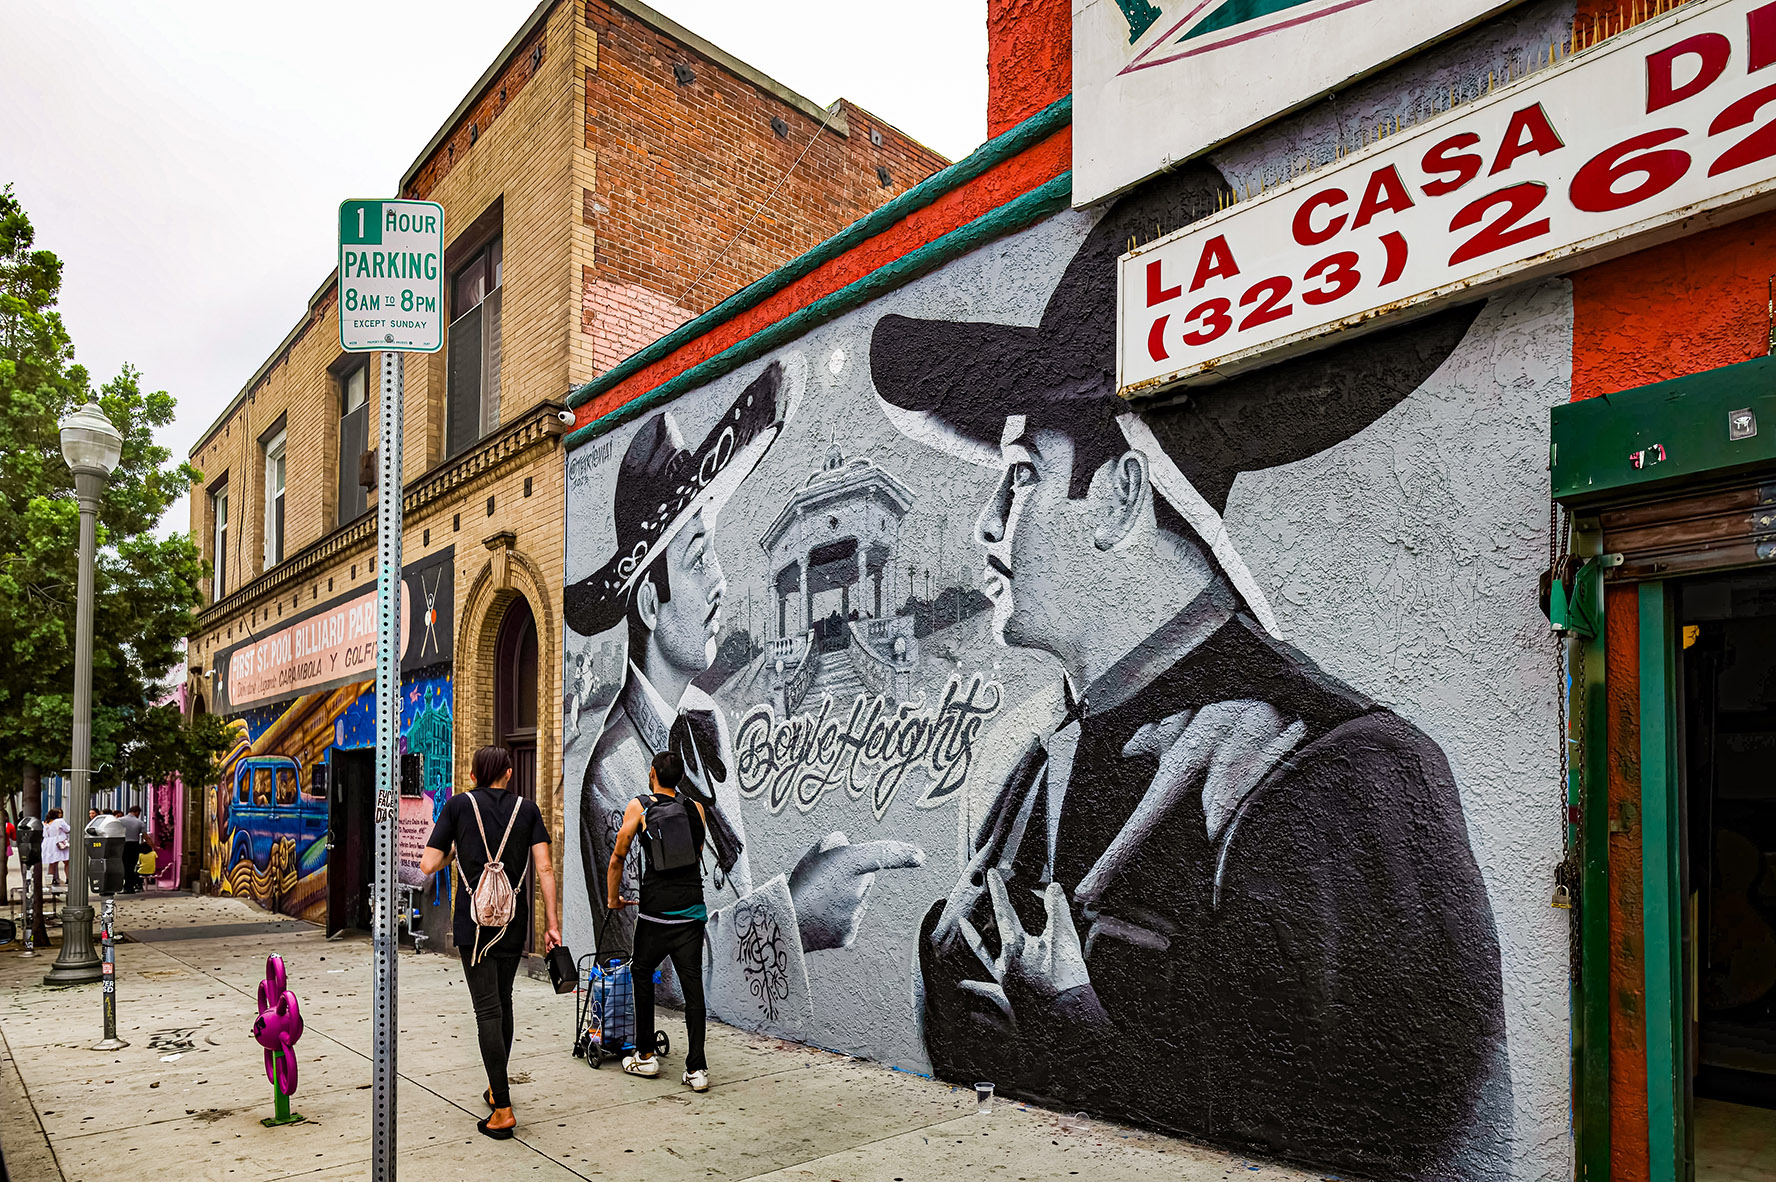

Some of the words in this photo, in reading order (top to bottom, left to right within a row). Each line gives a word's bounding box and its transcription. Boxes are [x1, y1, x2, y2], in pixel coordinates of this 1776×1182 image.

[357, 208, 365, 238] 1
[386, 213, 436, 233] HOUR
[1146, 233, 1240, 308] LA
[1292, 101, 1565, 246] CASA
[345, 251, 437, 280] PARKING
[345, 288, 380, 311] 8AM
[385, 296, 395, 304] TO
[401, 289, 436, 313] 8PM
[1147, 230, 1408, 362] (323)
[354, 320, 386, 328] EXCEPT
[390, 320, 427, 329] SUNDAY
[232, 648, 255, 681] FIRST
[257, 643, 269, 673] ST.
[271, 633, 292, 668] POOL
[295, 612, 344, 659] BILLIARD
[279, 658, 322, 687] CARAMBOLA
[330, 652, 338, 672] Y
[345, 641, 378, 668] GOLFI
[734, 694, 840, 817] Boyle
[832, 672, 1004, 821] Heights
